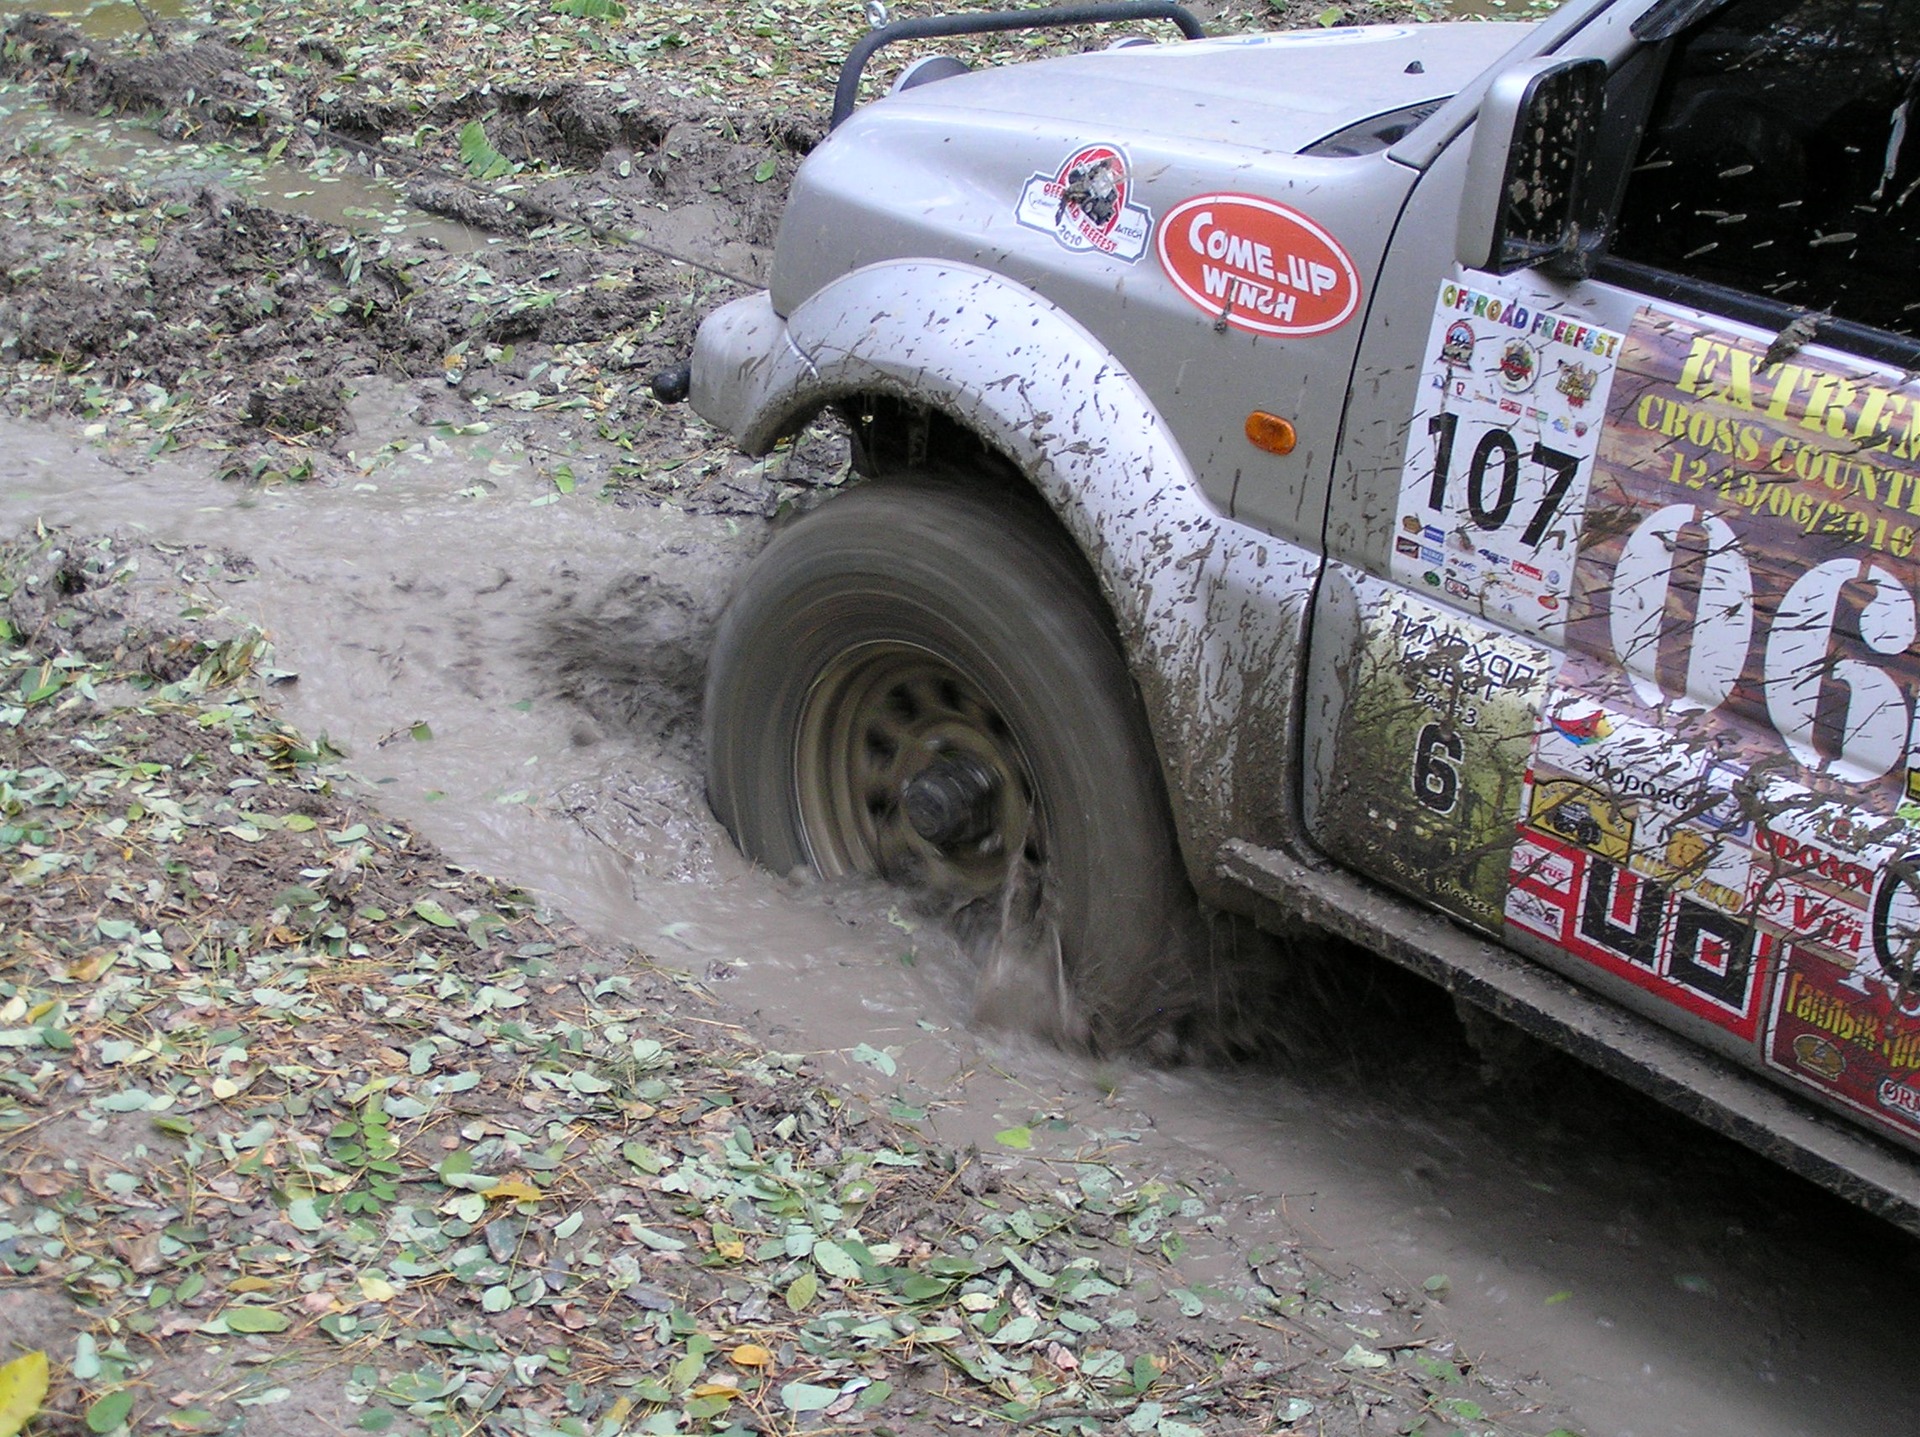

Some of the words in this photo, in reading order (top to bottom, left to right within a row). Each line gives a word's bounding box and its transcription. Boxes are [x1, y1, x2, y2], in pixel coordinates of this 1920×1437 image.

[1057, 225, 1083, 246] 2010
[1078, 217, 1118, 253] FREEFEST
[1202, 263, 1298, 323] WINCH
[1442, 284, 1529, 330] OFFROAD
[1531, 312, 1620, 359] FREEFEST
[1637, 393, 1764, 462] CROSS
[1428, 412, 1580, 547] 107
[1609, 503, 1917, 783] 06
[1411, 721, 1466, 815] 6
